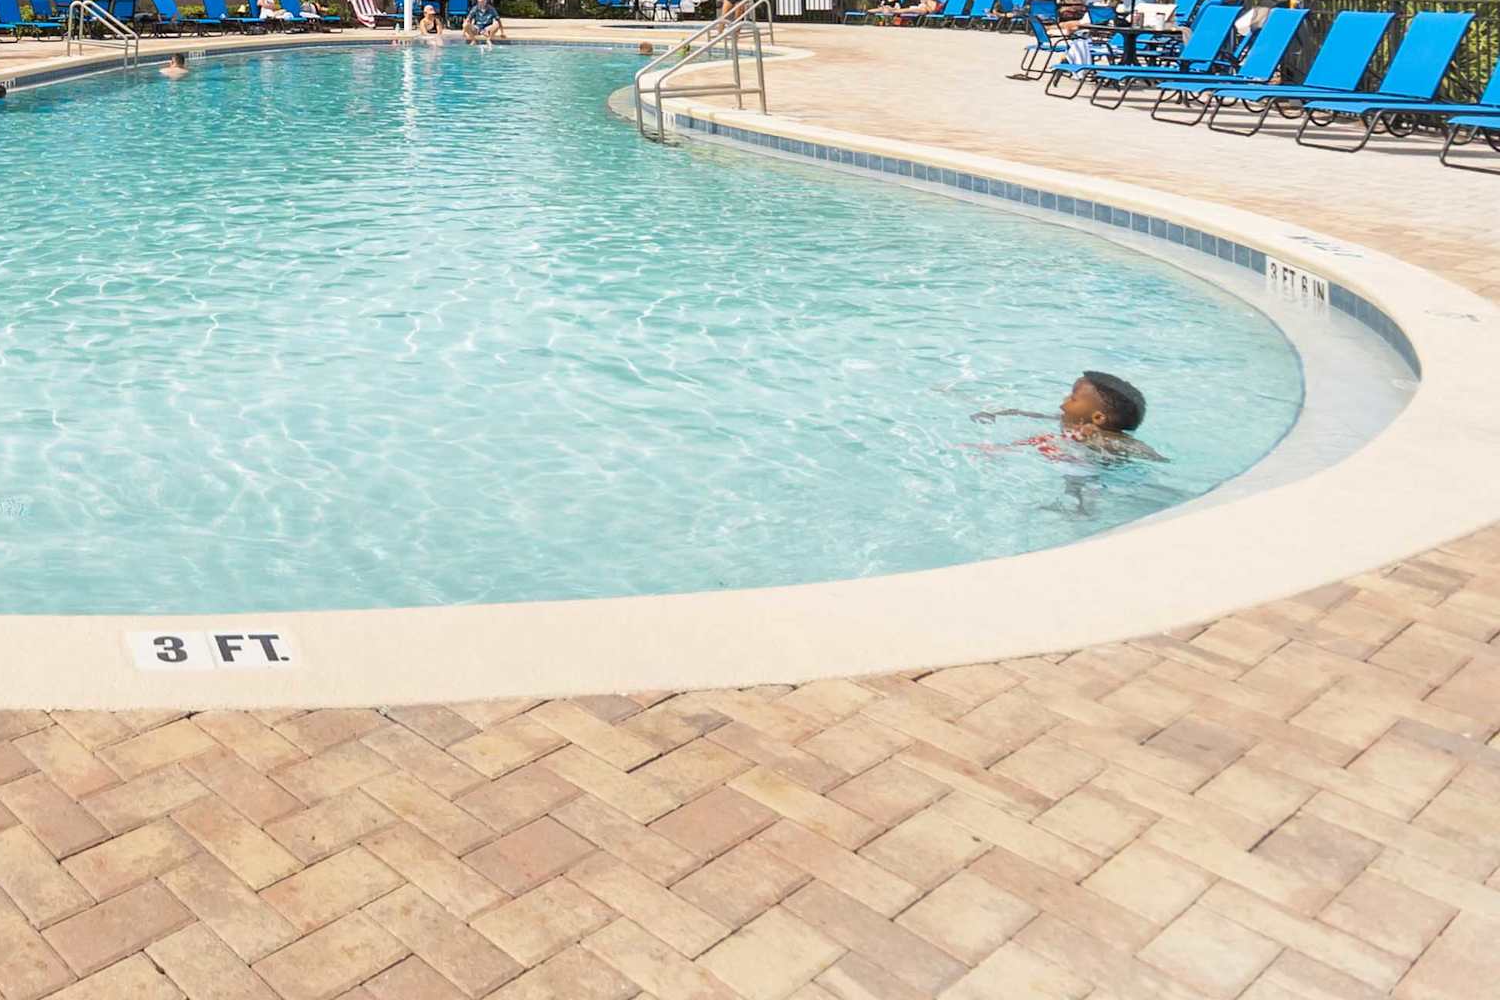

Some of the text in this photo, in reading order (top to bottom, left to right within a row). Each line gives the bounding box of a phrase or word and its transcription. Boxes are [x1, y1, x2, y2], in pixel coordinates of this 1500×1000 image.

[1270, 262, 1277, 280] 3
[1282, 267, 1296, 288] FT
[1313, 280, 1325, 301] IN
[153, 633, 290, 663] 3 FT.
